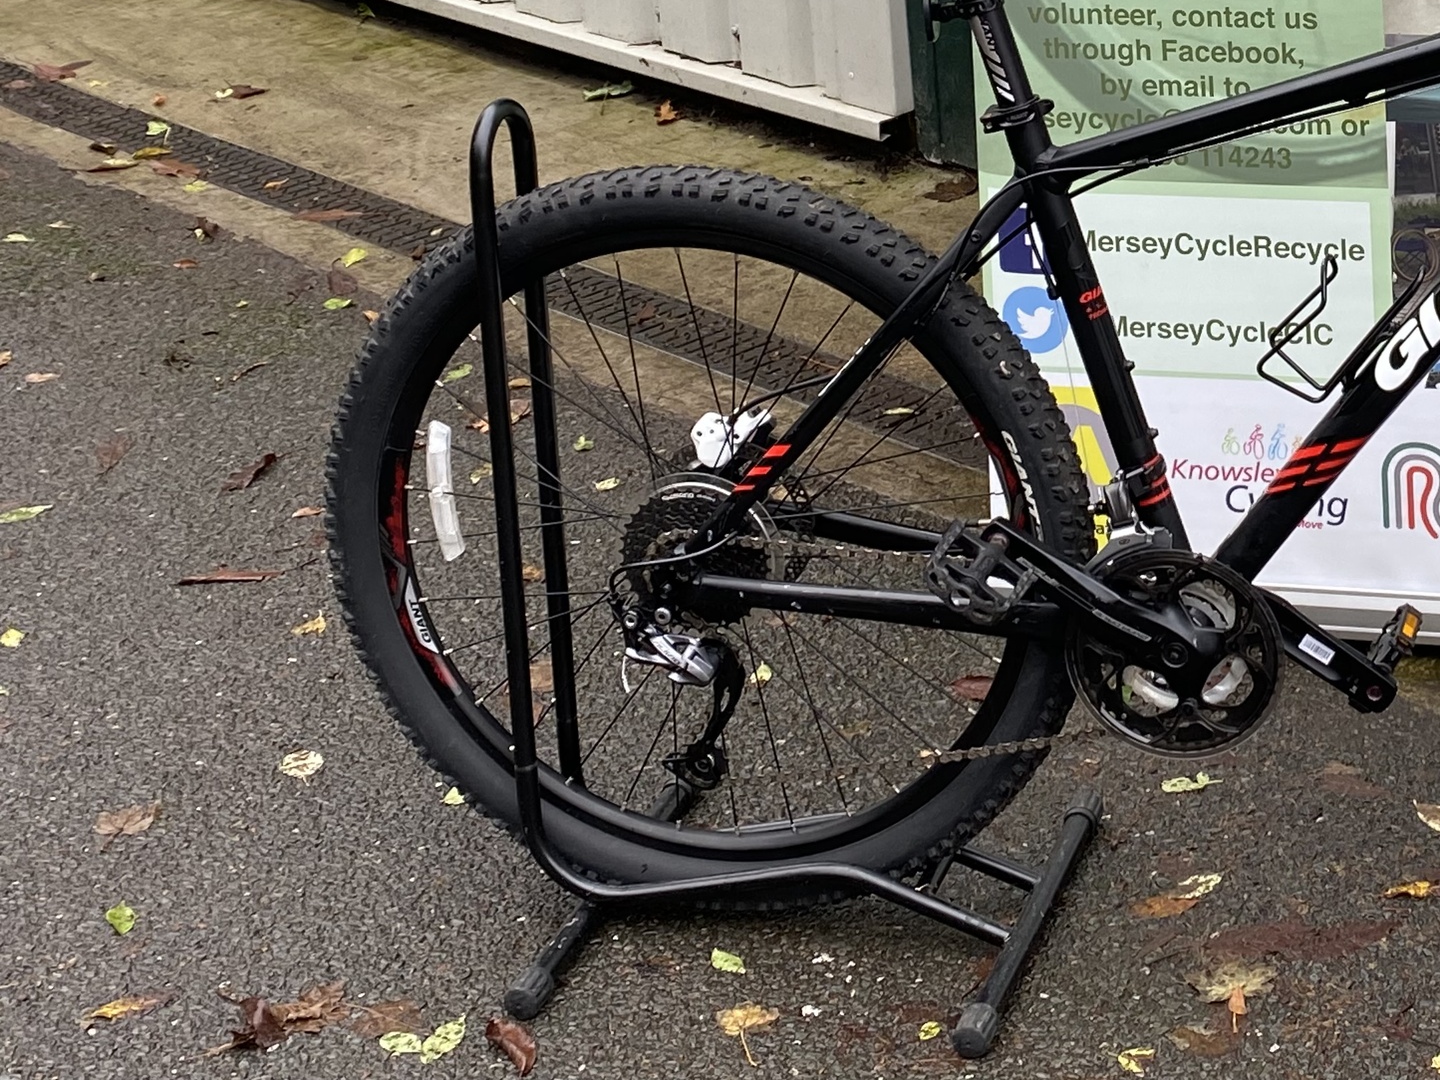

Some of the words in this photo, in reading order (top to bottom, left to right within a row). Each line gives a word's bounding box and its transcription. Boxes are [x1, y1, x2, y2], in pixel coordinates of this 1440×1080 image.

[1028, 3, 1163, 30] volunteer,
[1171, 5, 1275, 29] contact
[1285, 9, 1318, 30] us
[1043, 37, 1151, 63] through
[1161, 39, 1304, 68] Facebook,
[1100, 73, 1132, 100] by
[1142, 74, 1215, 97] email
[1223, 76, 1251, 96] to
[1341, 117, 1370, 136] or
[1171, 459, 1282, 483] Knowsle
[409, 599, 432, 644] GIANT
